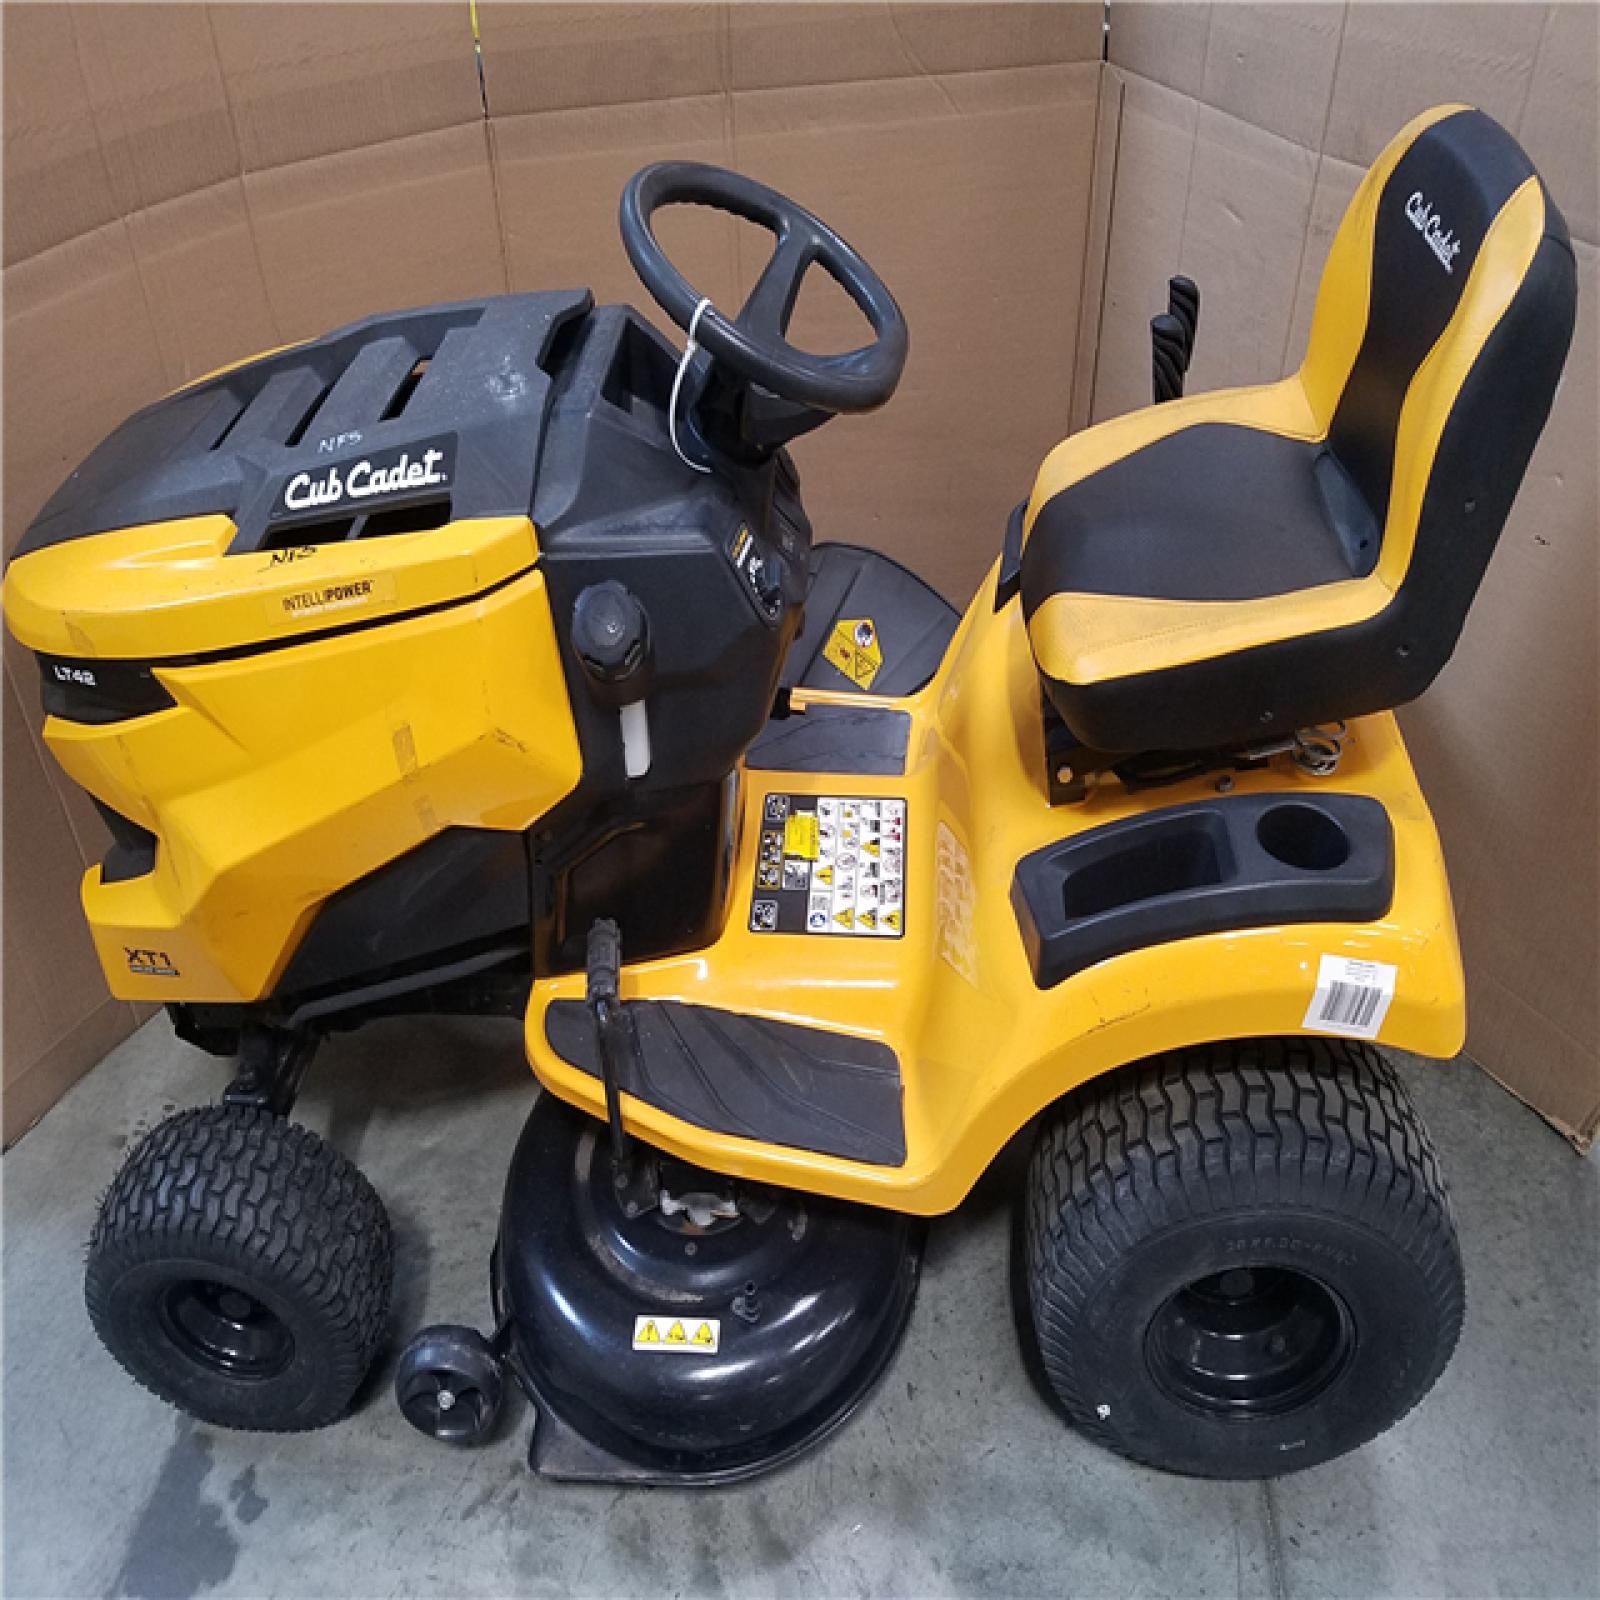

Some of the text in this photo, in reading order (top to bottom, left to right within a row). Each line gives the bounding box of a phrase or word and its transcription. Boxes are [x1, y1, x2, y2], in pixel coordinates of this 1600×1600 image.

[1404, 191, 1461, 274] Cub Cadet
[284, 448, 444, 510] Cub Cadet
[281, 580, 371, 611] INTELLIPOWER
[122, 945, 171, 967] XT1
